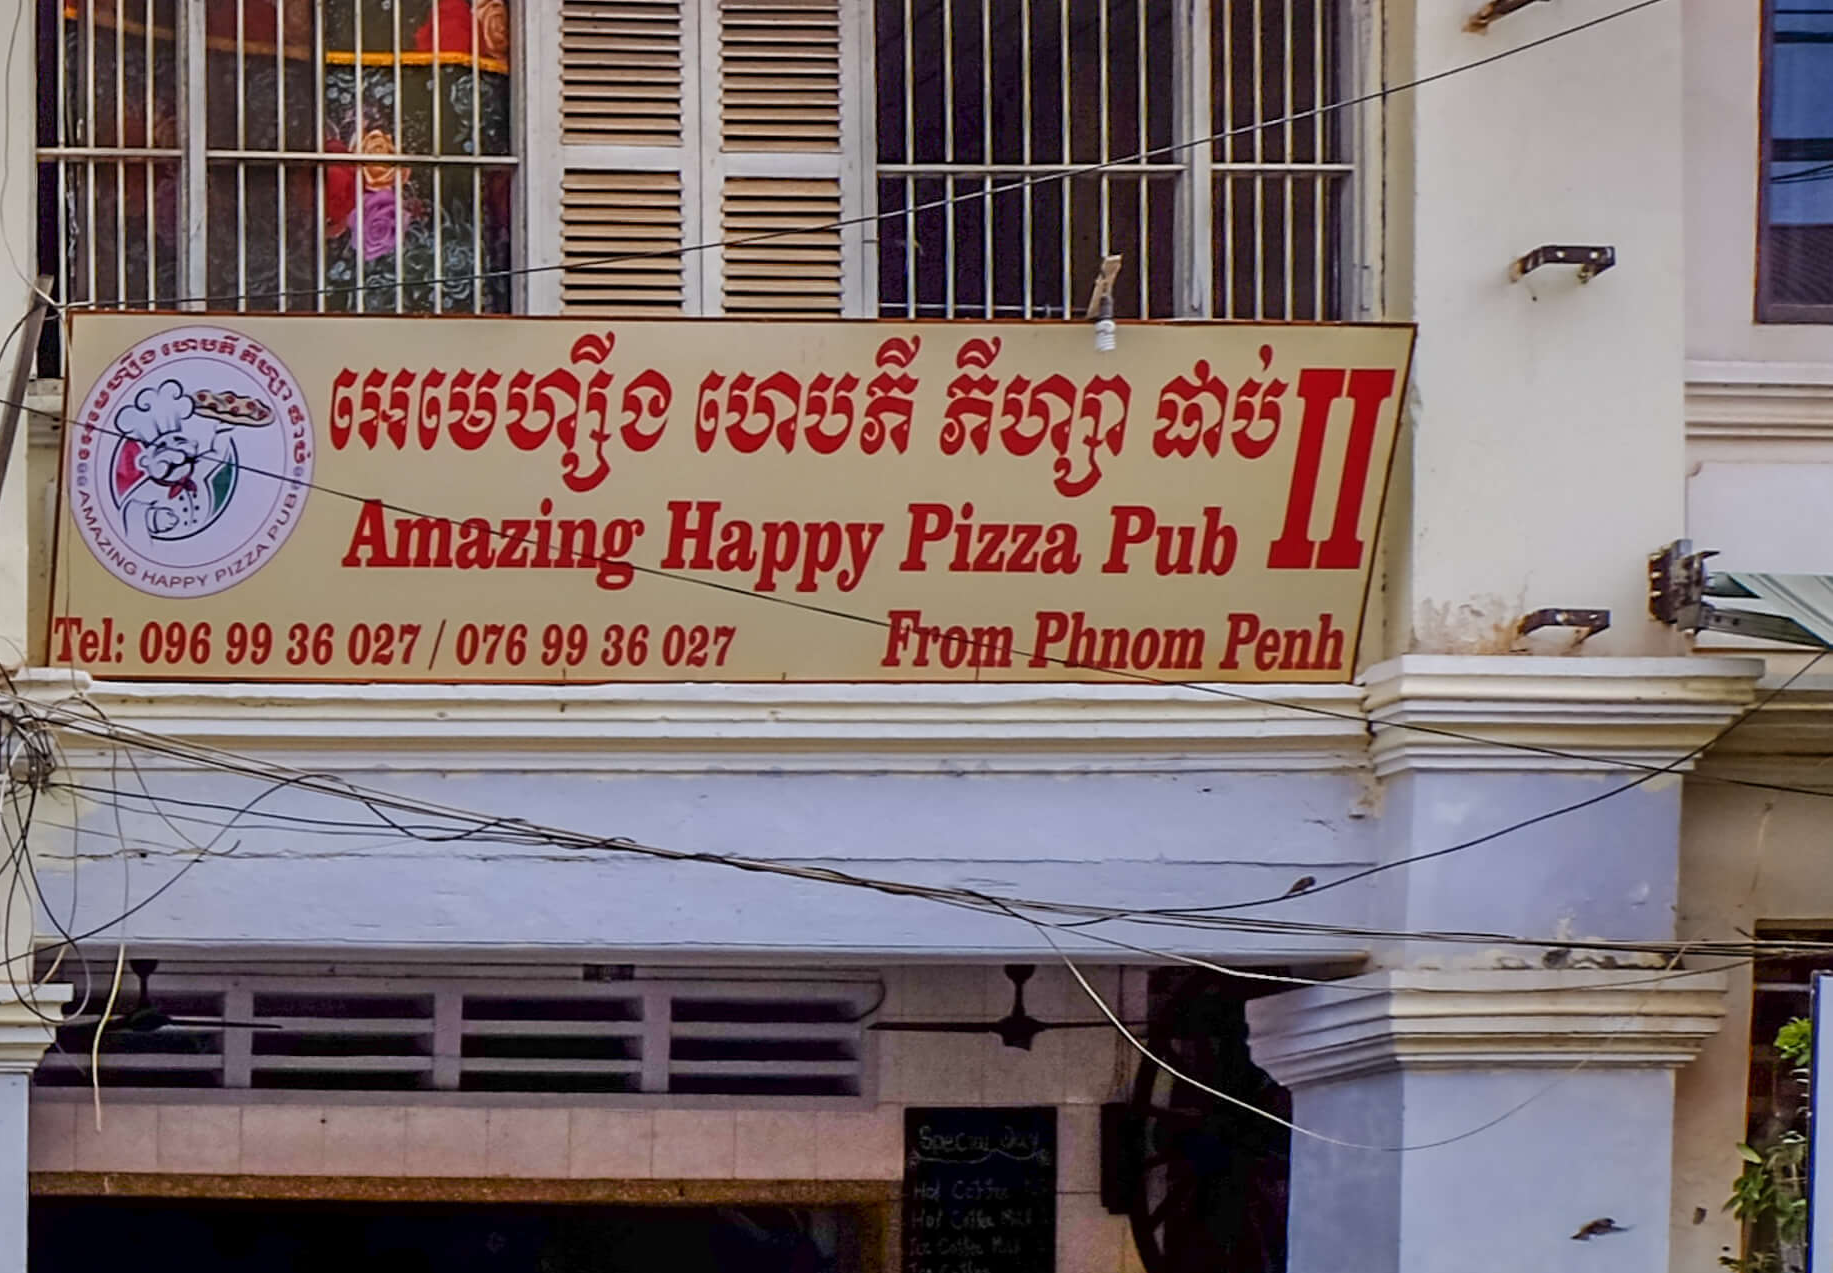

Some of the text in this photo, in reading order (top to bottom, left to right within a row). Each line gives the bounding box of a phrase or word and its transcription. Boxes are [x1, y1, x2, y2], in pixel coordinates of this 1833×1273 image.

[1266, 368, 1396, 569] II
[78, 490, 298, 590] AMAZING HAPPY PIZZA PUB
[341, 498, 1238, 592] Amazing Happy Pizza Pub
[55, 616, 735, 670] Tel: 096 99 36 027 / 076 99 36 027
[881, 610, 1344, 671] From Phnom Penh
